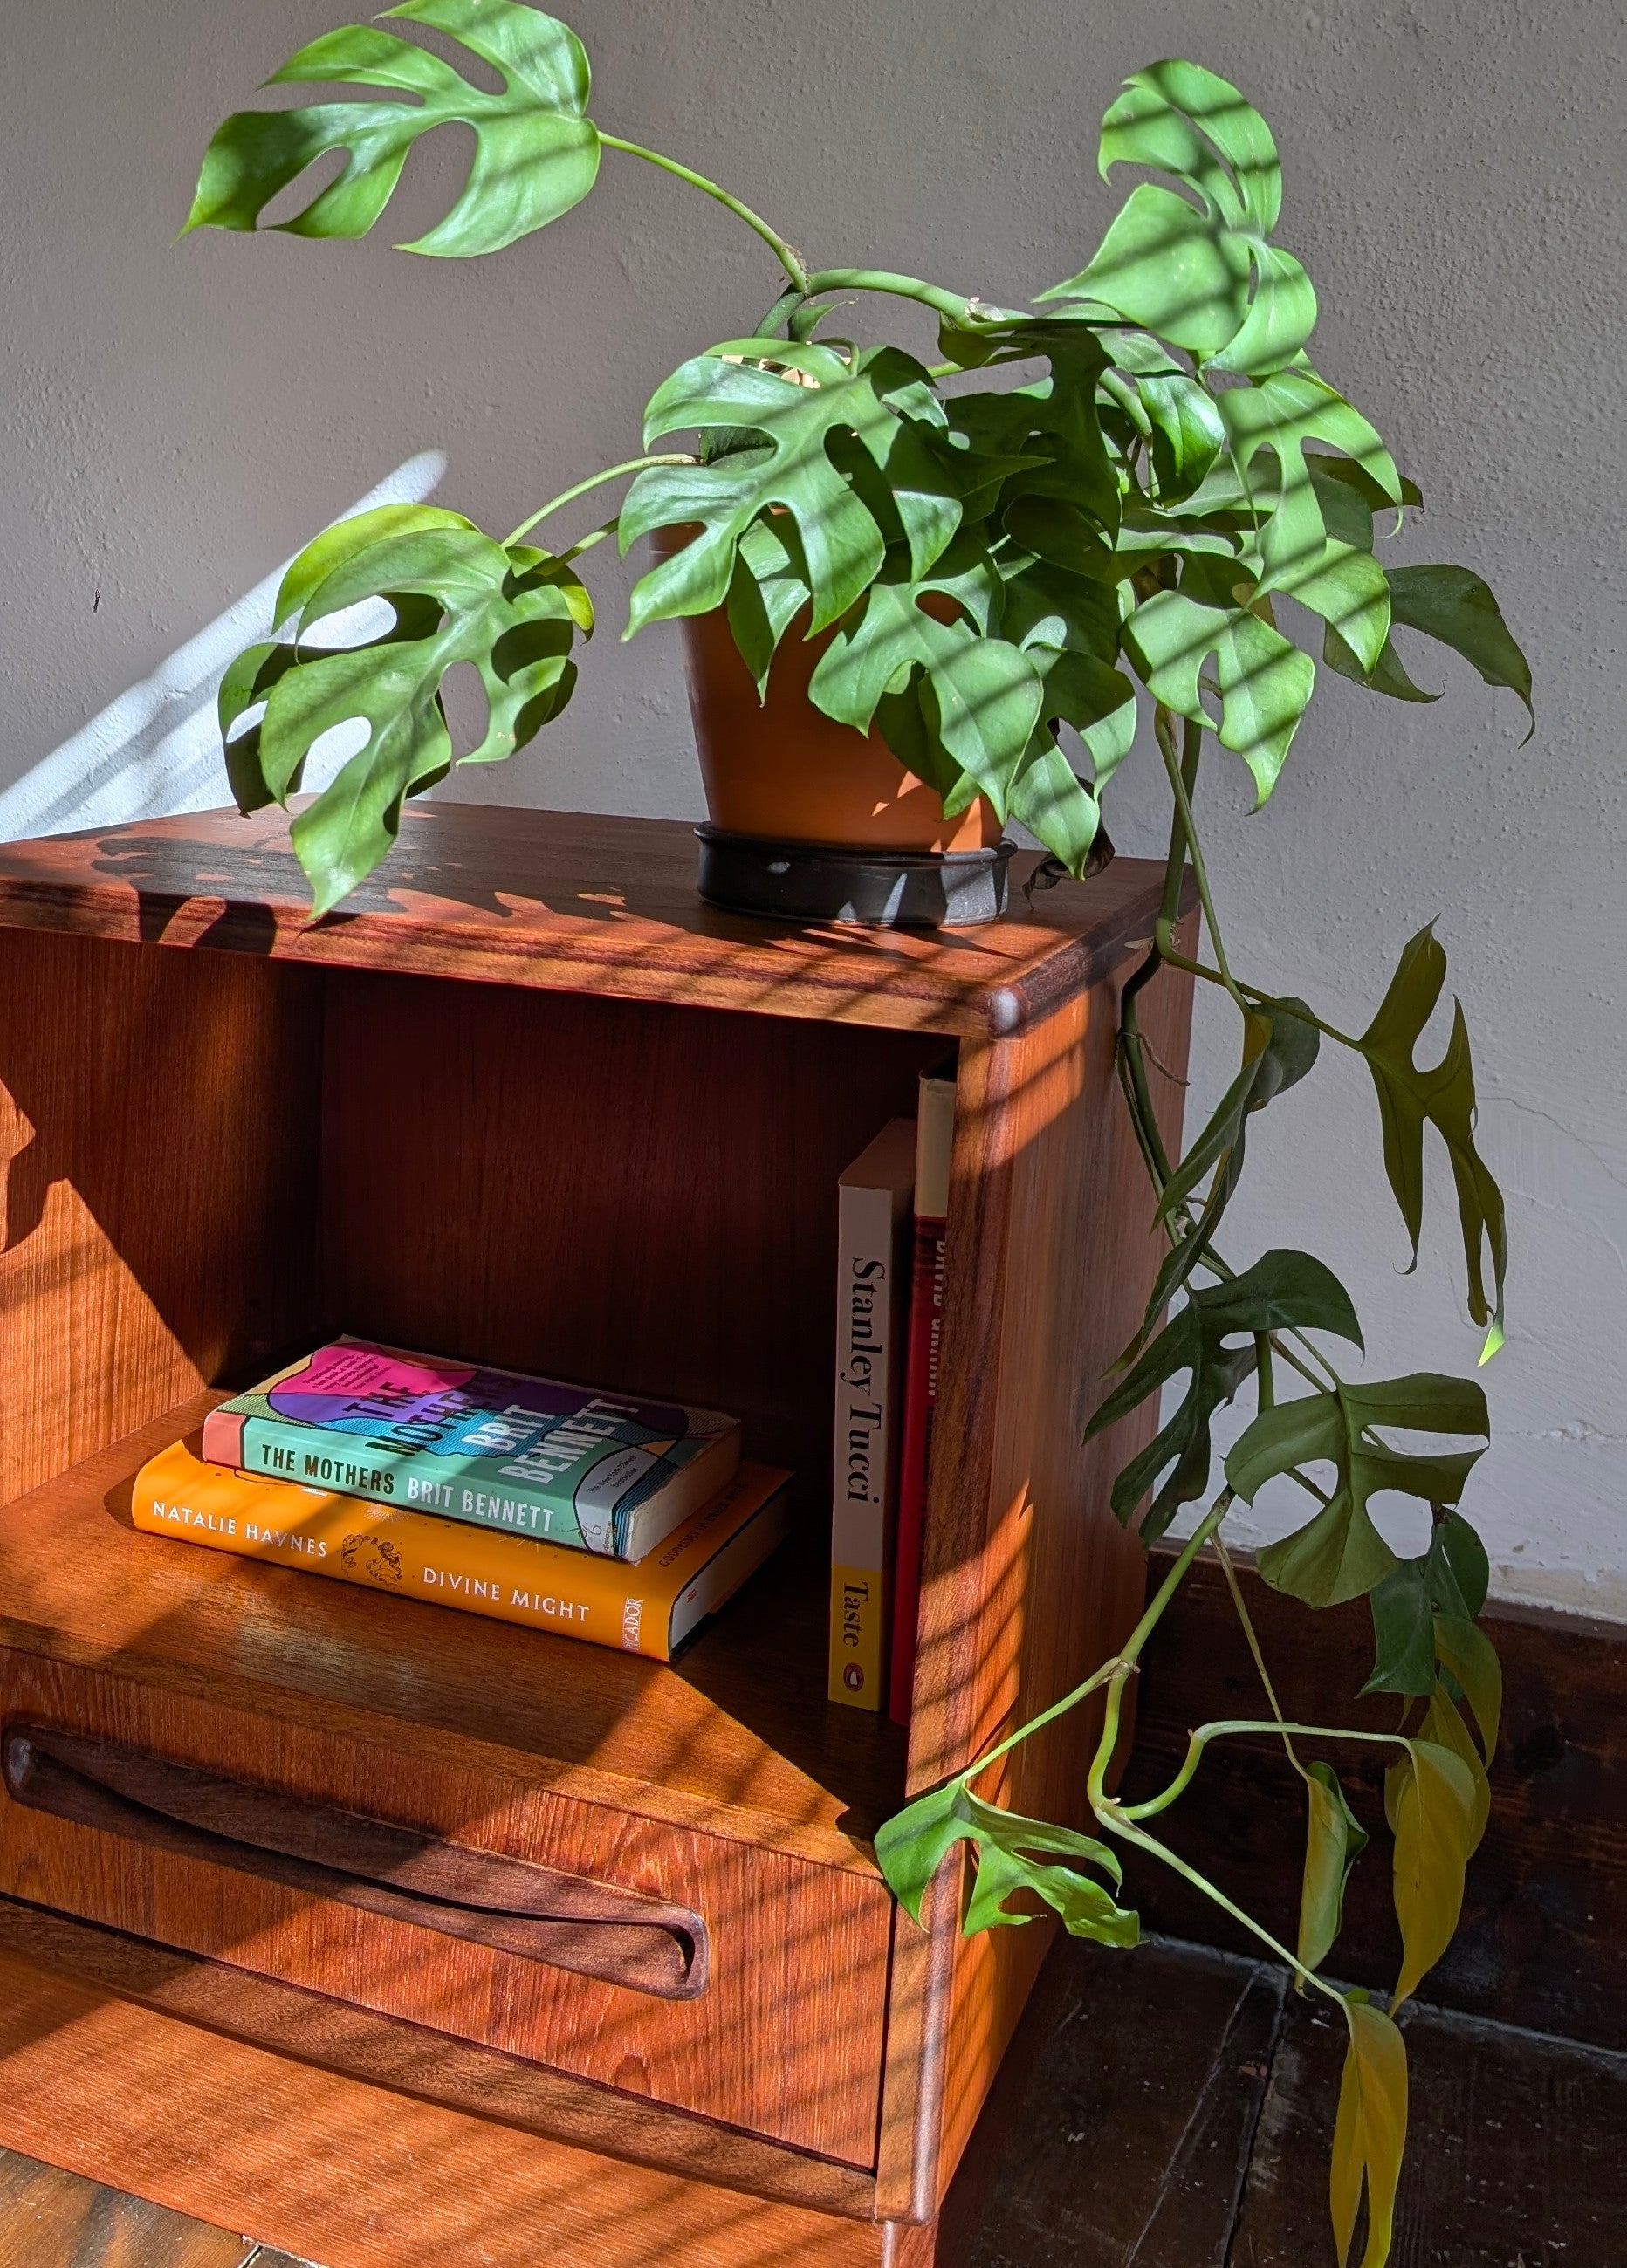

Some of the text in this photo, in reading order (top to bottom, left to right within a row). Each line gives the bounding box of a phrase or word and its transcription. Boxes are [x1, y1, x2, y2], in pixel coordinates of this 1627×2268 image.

[342, 1381, 430, 1418] THE
[840, 1257, 886, 1504] Stanley Tucci
[461, 1404, 556, 1451] BRIT
[497, 1398, 639, 1483] BENNETT
[262, 1444, 555, 1531] THE MOTHERS BRIT BENNETT
[153, 1501, 590, 1621] NATALIE HAYNES DIVINE MIGHT
[843, 1581, 868, 1648] Taste
